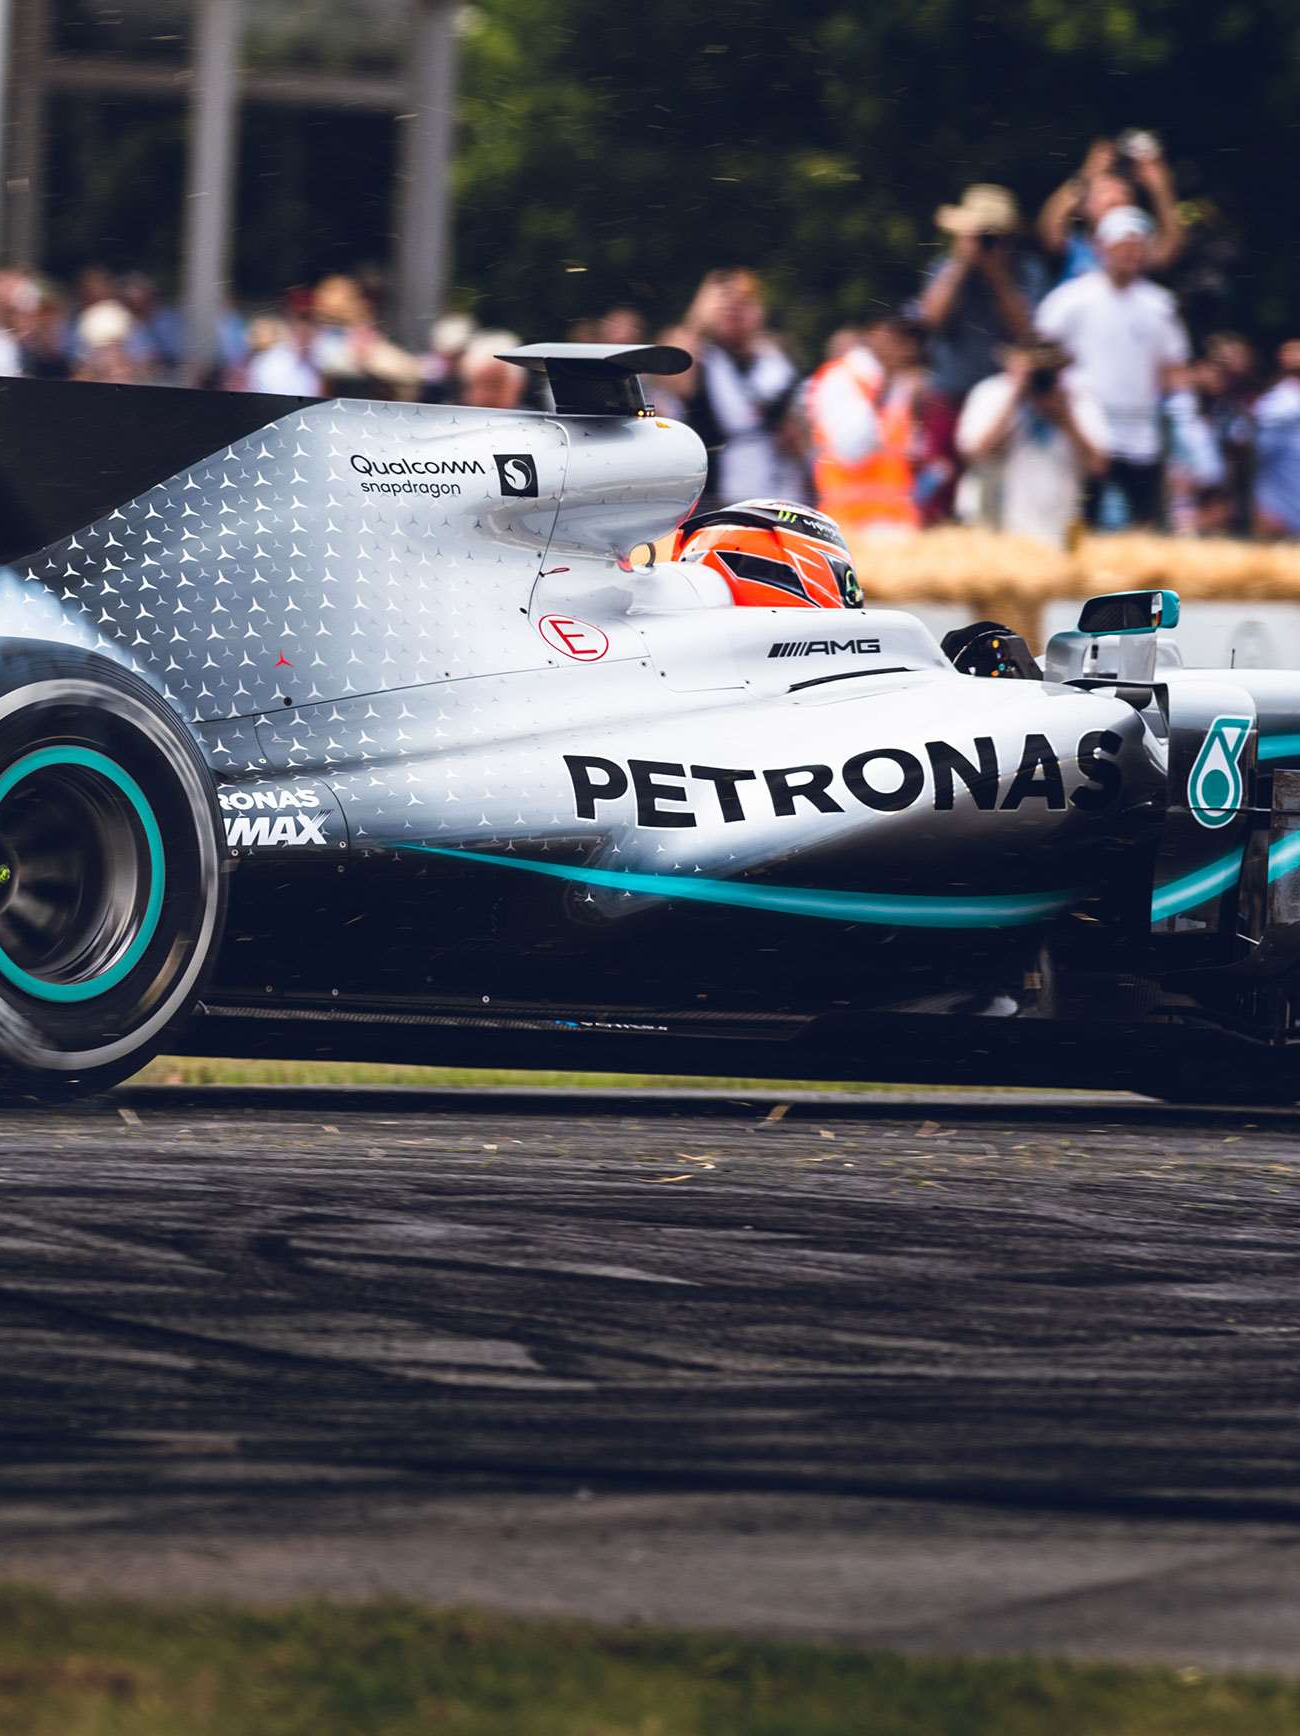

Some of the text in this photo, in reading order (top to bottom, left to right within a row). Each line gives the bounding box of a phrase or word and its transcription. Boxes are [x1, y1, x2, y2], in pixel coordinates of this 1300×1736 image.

[350, 454, 486, 477] Qualcomm
[360, 480, 461, 498] snapdragon
[548, 620, 598, 655] E
[803, 639, 881, 655] AMG
[562, 729, 1125, 829] PETRONAS
